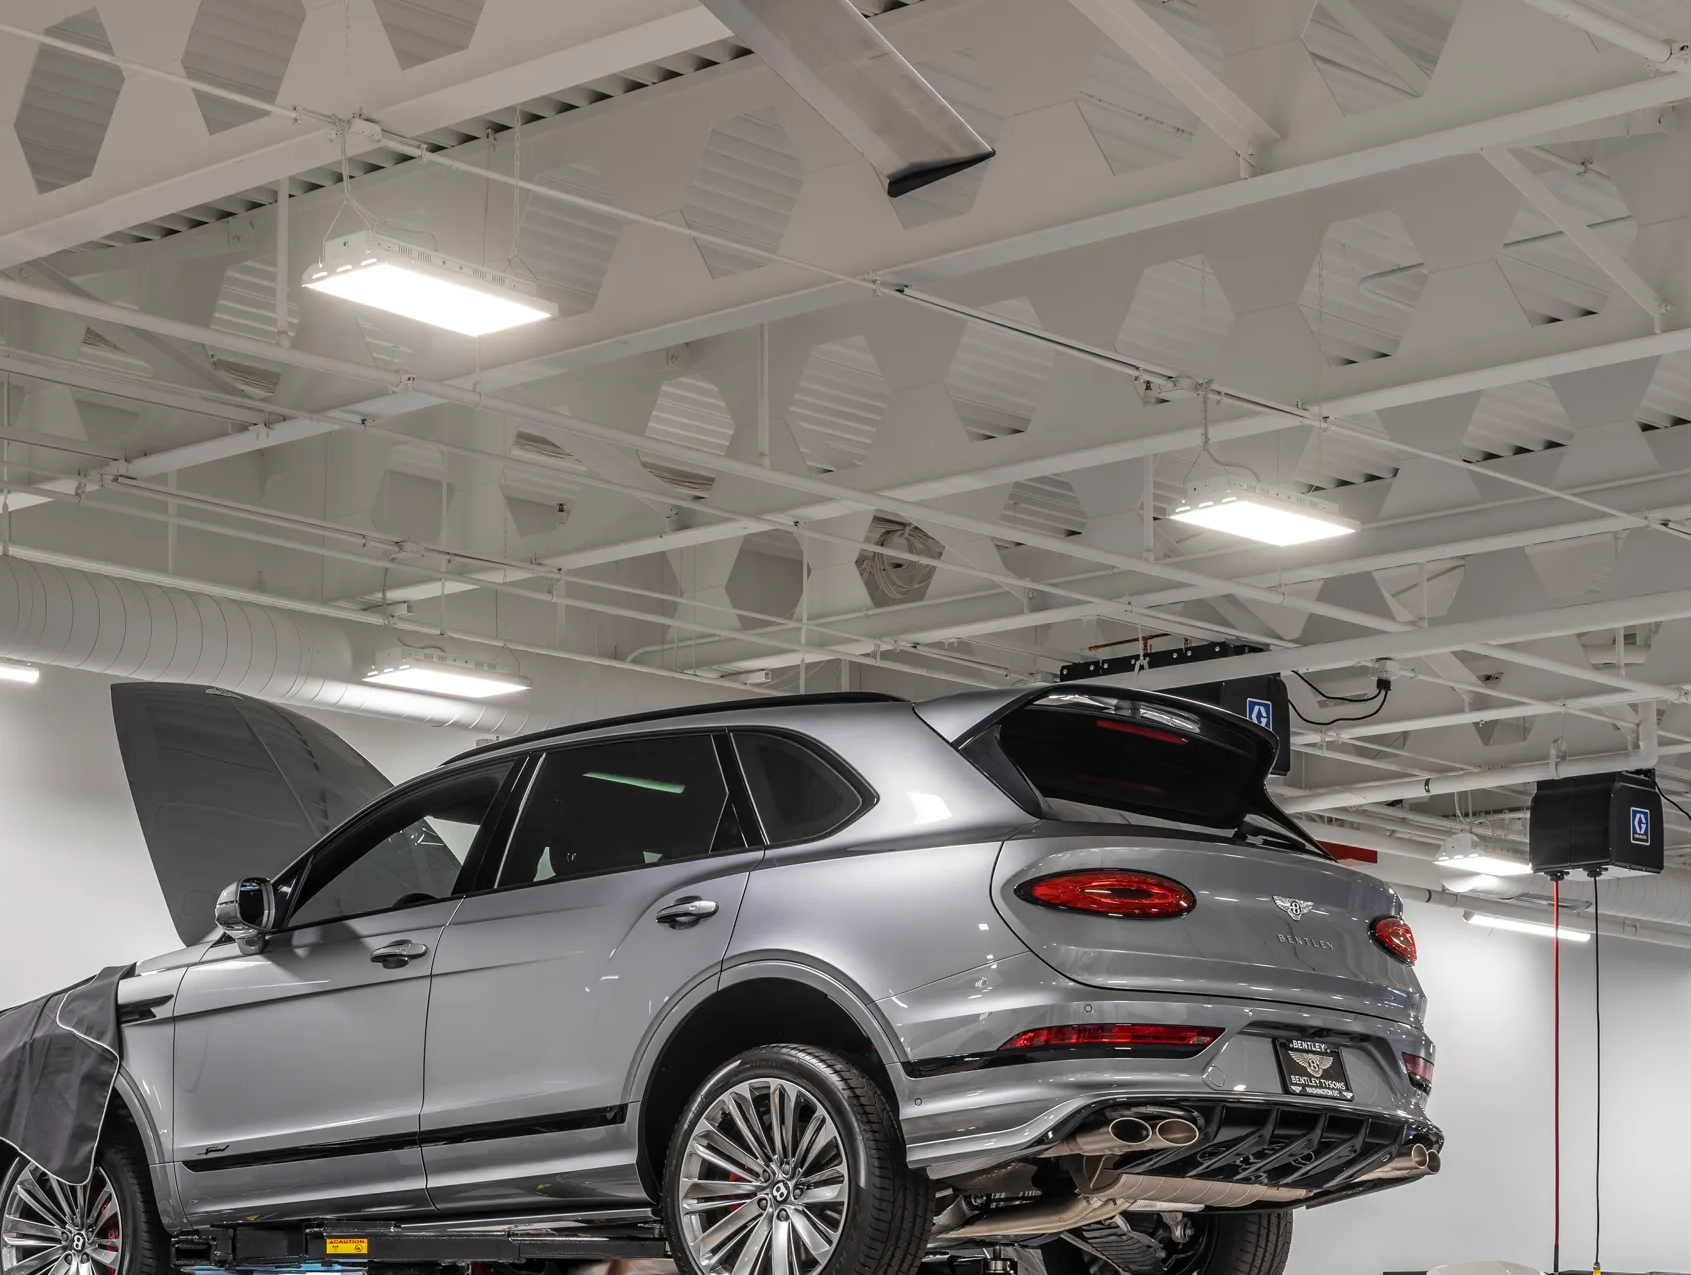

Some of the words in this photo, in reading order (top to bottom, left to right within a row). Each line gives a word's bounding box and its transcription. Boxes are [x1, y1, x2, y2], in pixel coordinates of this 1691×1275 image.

[1277, 933, 1334, 951] BENTLEY
[1292, 1040, 1325, 1052] BENTLEY
[1291, 1075, 1320, 1086] BENTLEY
[1320, 1079, 1346, 1090] TYSONS
